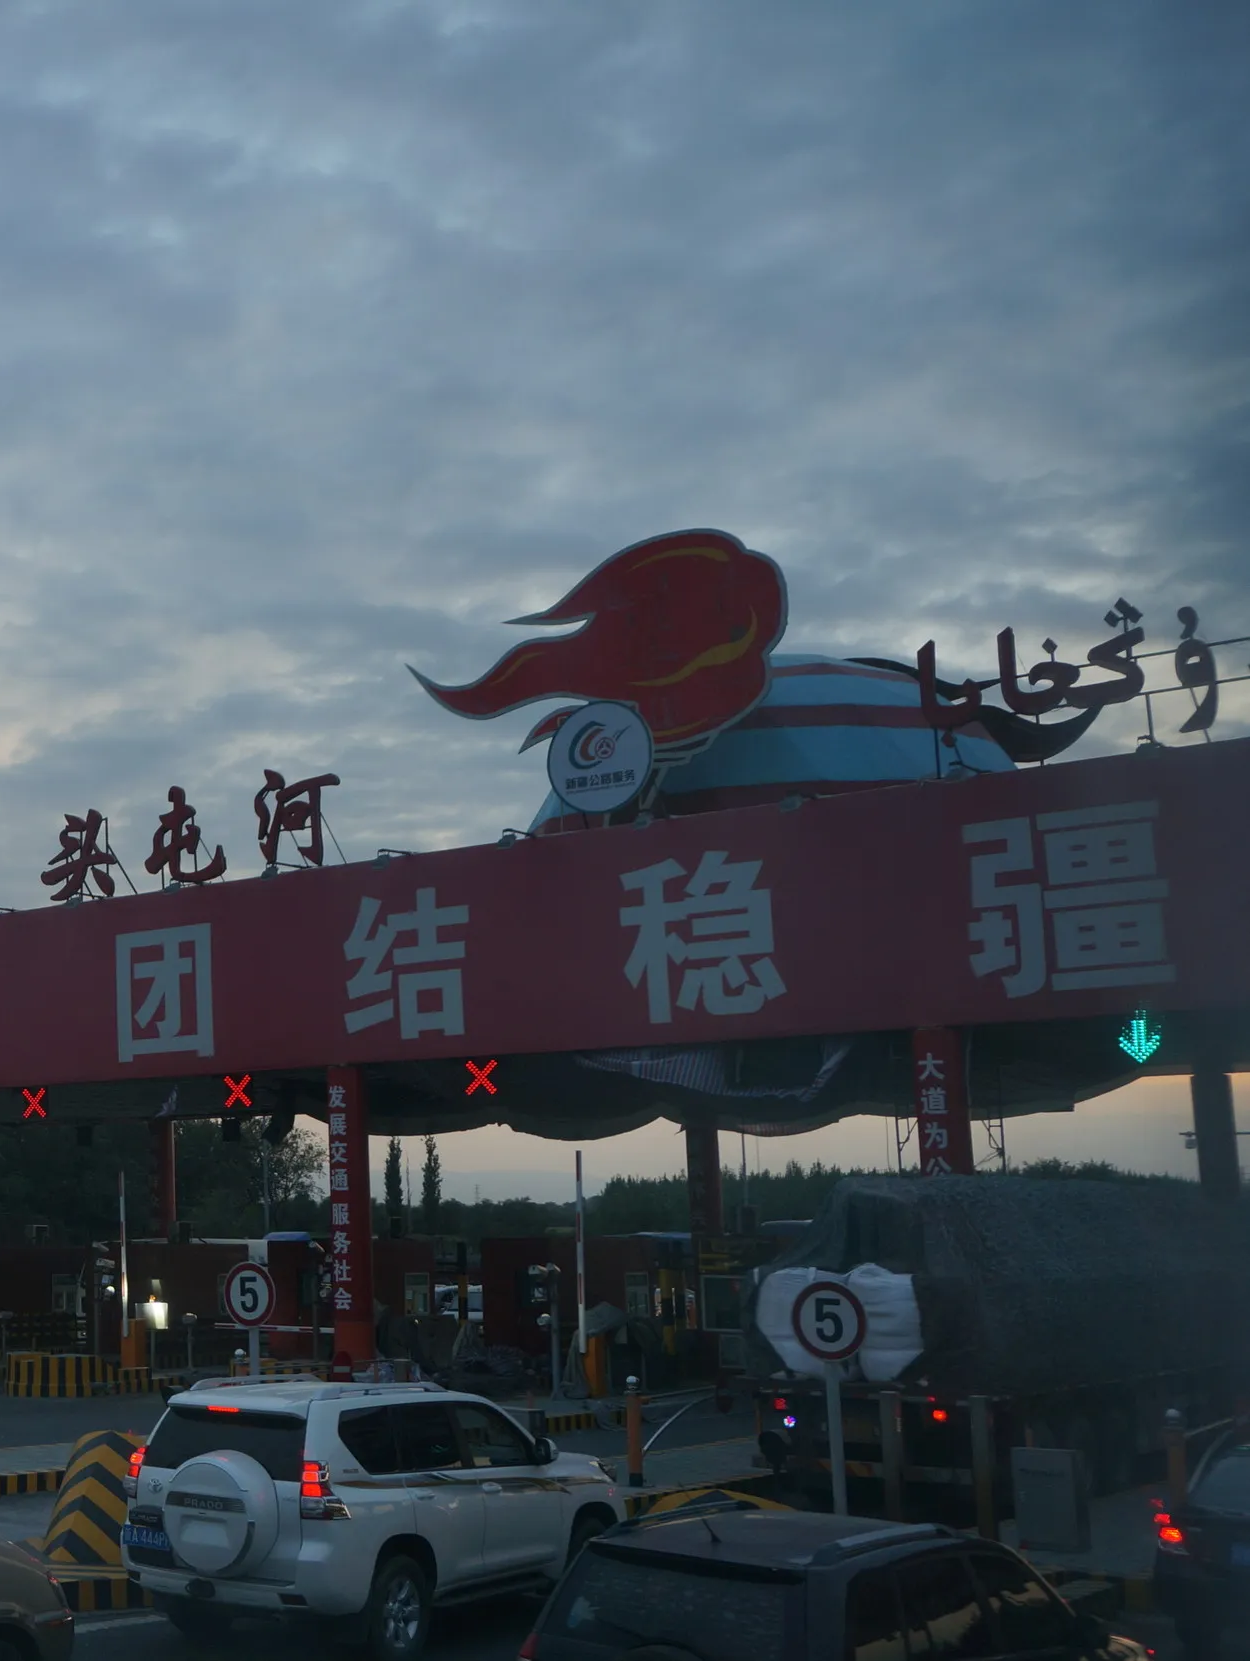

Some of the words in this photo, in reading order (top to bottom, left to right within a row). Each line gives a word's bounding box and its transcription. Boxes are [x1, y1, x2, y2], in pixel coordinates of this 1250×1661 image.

[39, 768, 341, 902] 头屯河
[239, 1276, 259, 1313] 5
[815, 1298, 844, 1343] 5
[183, 1497, 224, 1510] PRADO
